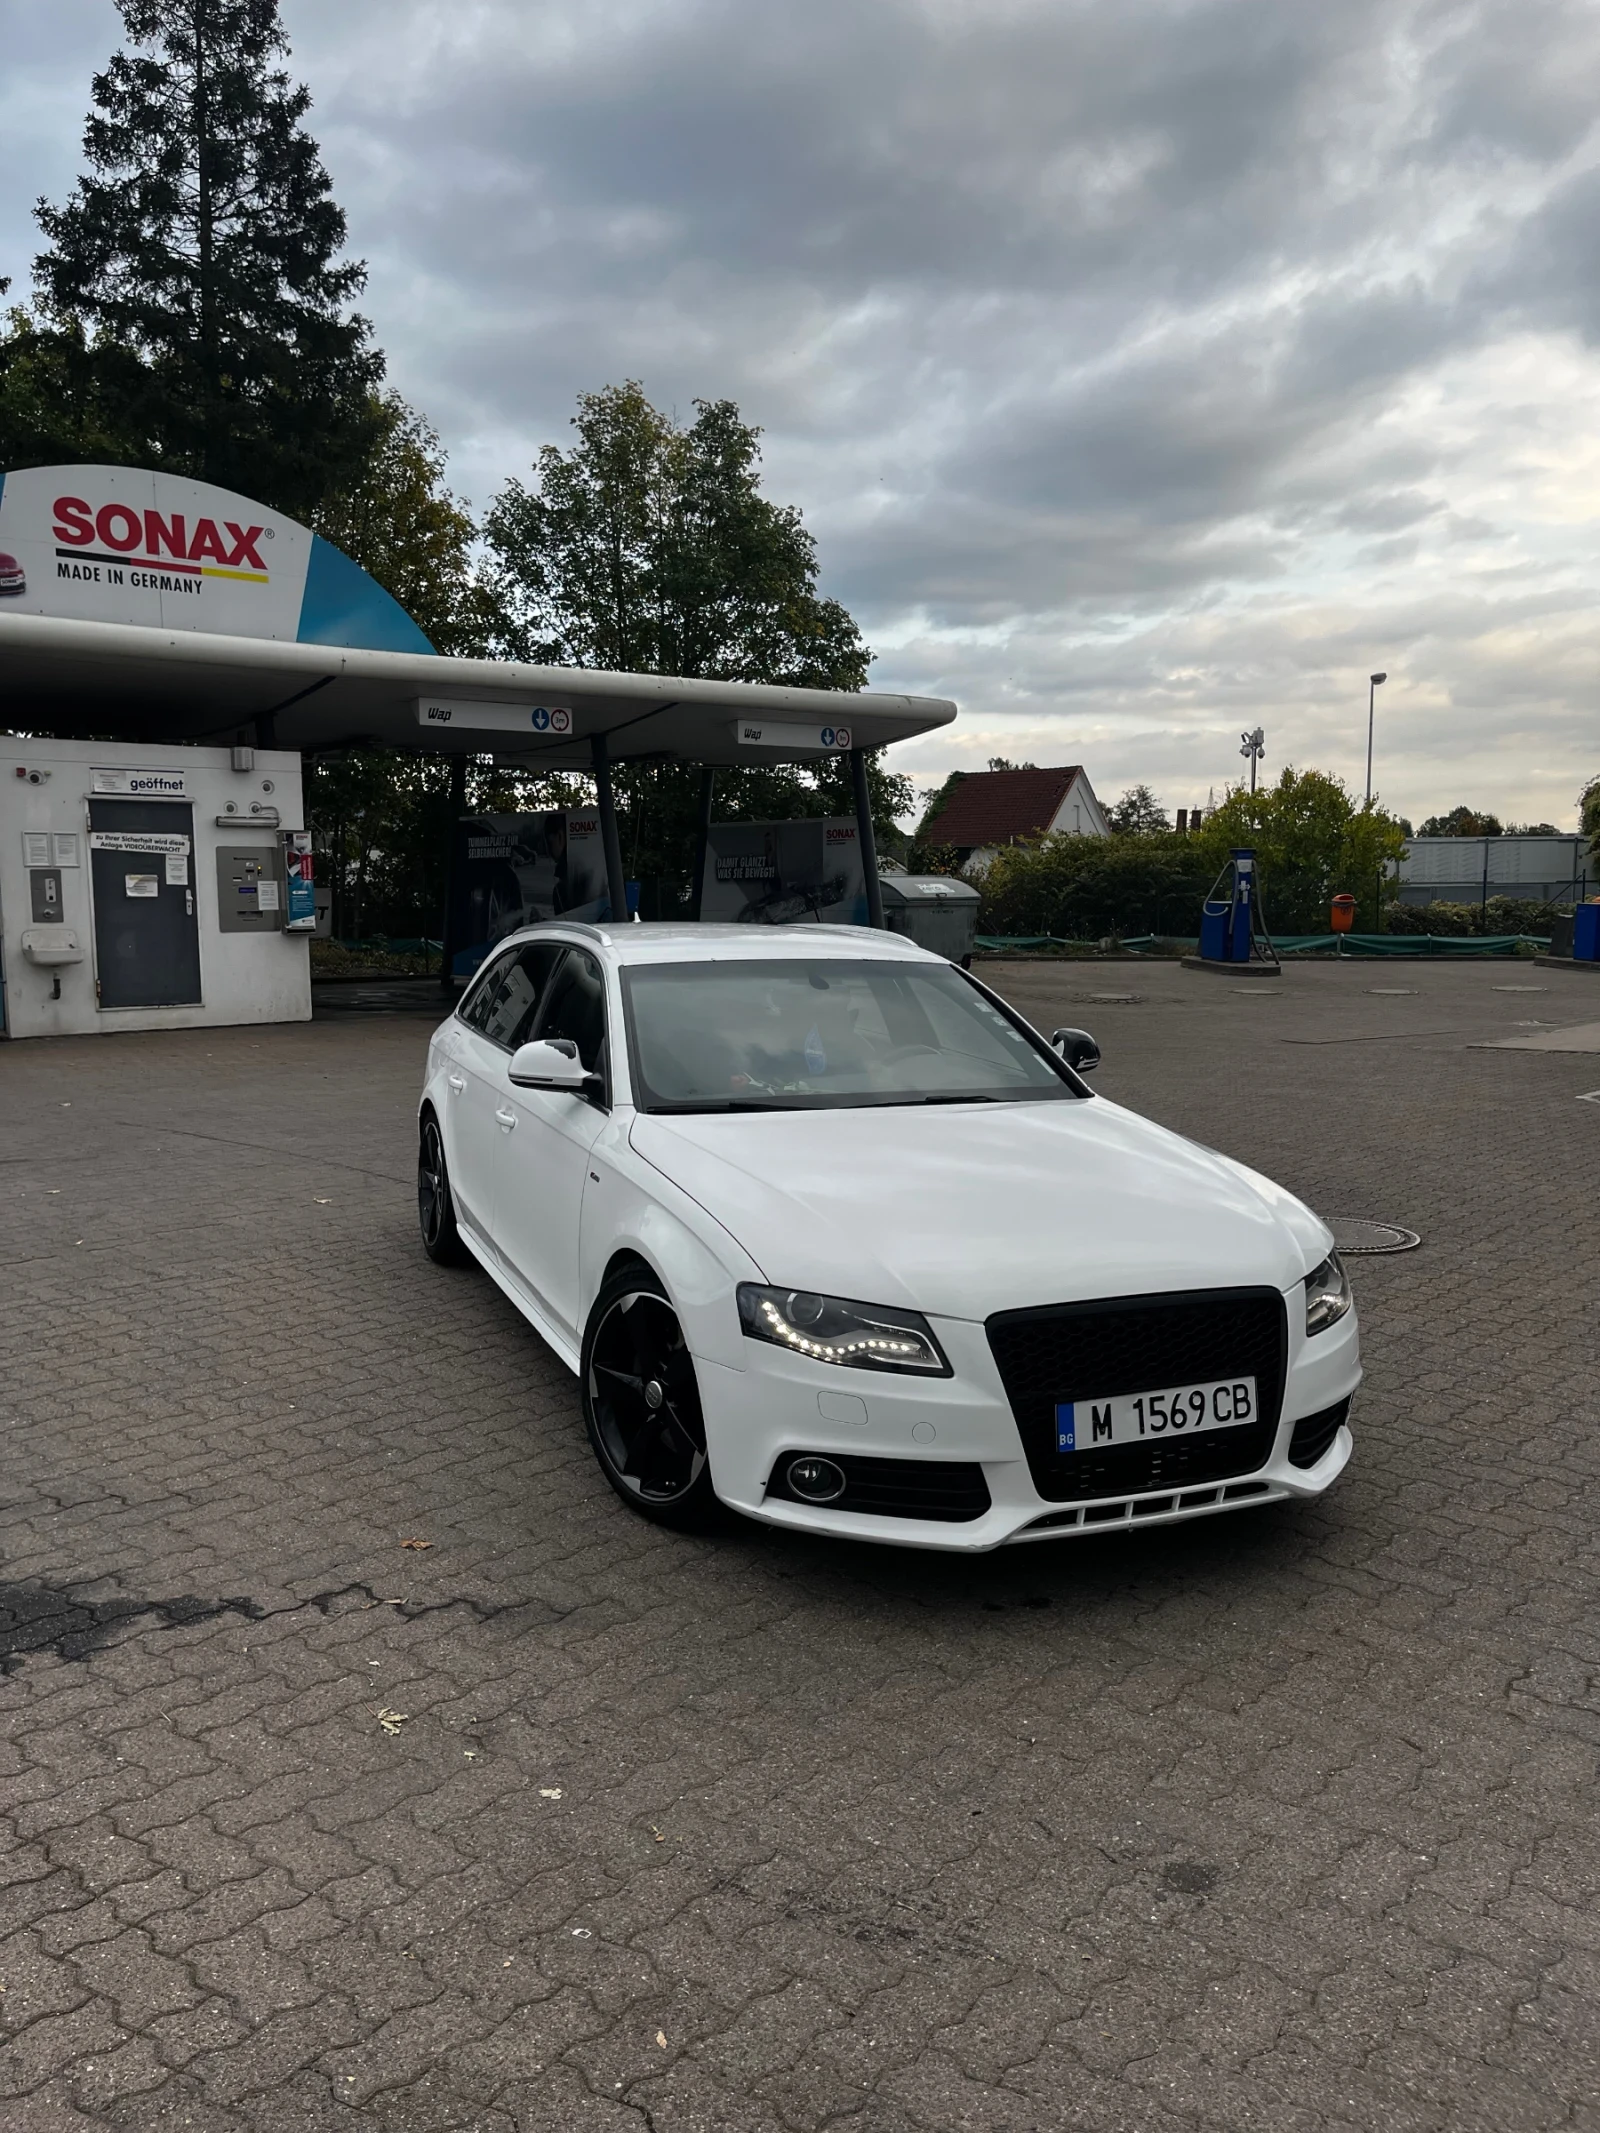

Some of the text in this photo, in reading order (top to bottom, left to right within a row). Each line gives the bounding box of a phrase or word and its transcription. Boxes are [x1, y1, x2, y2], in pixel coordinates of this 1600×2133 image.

[52, 496, 268, 570] SONAX
[57, 562, 203, 595] MADE IN GERMANY
[428, 707, 451, 722] Wap
[555, 716, 566, 724] 3m
[744, 727, 762, 741] Wap
[130, 778, 184, 791] geöffnet
[569, 821, 598, 832] SONAX
[121, 836, 153, 844] Sicherheit
[826, 828, 856, 839] SONAX
[100, 841, 181, 852] Anlage VIDEOÜBERWACHT
[717, 854, 767, 868] DAMIT GLÄNZT
[717, 866, 775, 879] WAS SIE BEWEGT!
[1091, 1383, 1251, 1442] M 1569 CB
[1059, 1433, 1074, 1446] BG
